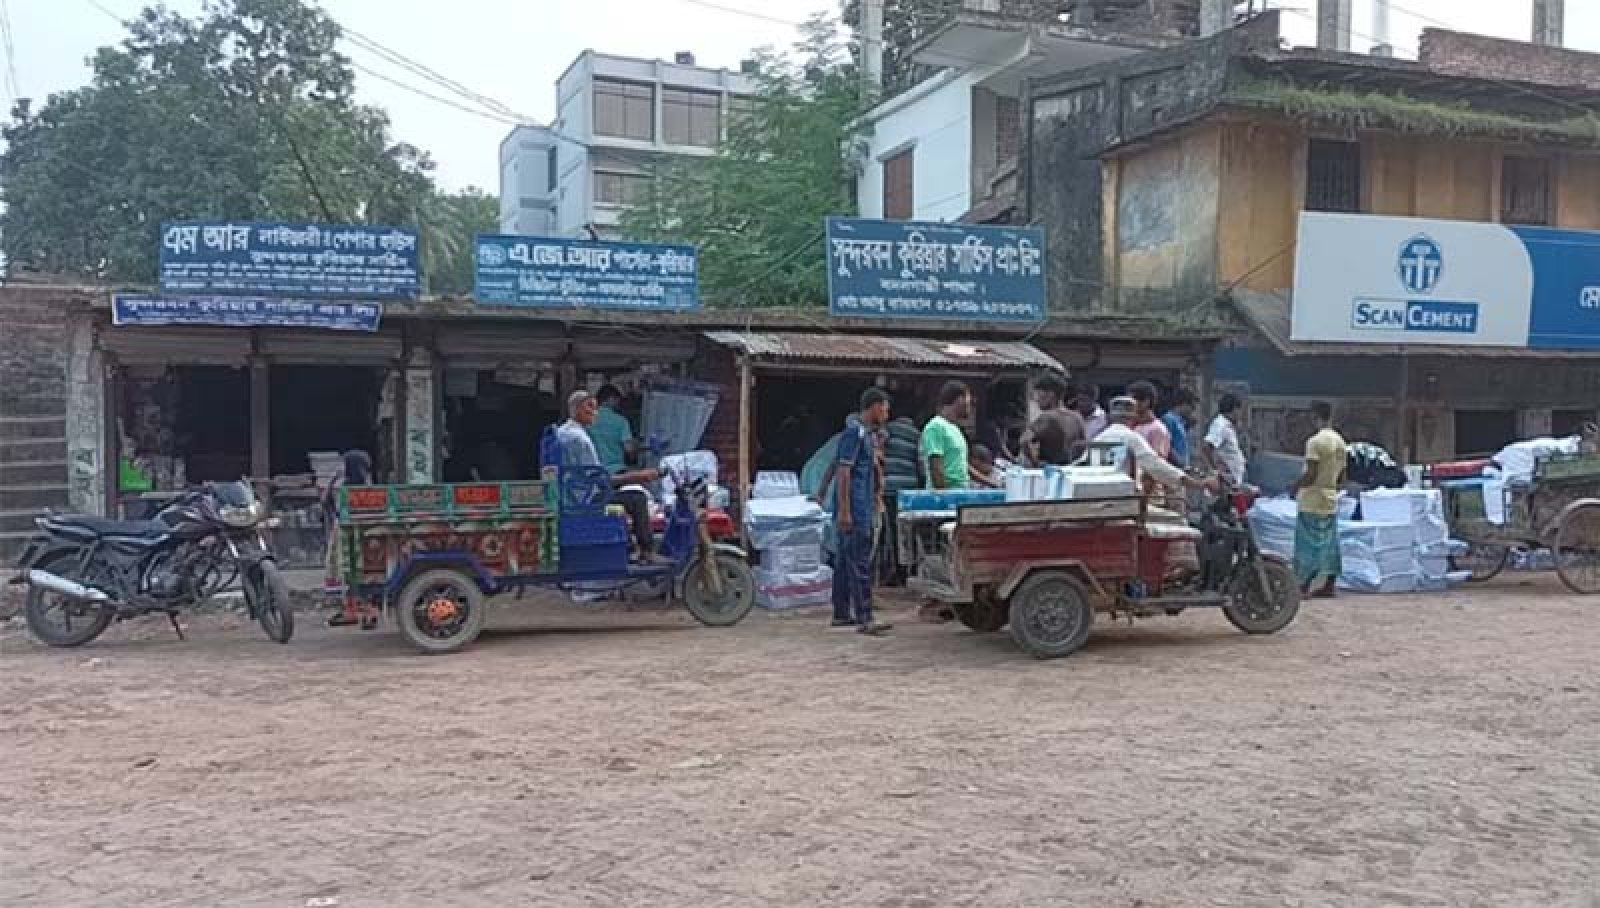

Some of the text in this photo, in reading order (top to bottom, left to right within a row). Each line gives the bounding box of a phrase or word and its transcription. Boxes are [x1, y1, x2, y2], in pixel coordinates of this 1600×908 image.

[163, 226, 200, 255] এম
[203, 223, 251, 251] আর
[832, 238, 893, 278] সুন্দরবন
[896, 231, 948, 279] কুরিয়ার
[951, 235, 993, 275] সার্ভিস
